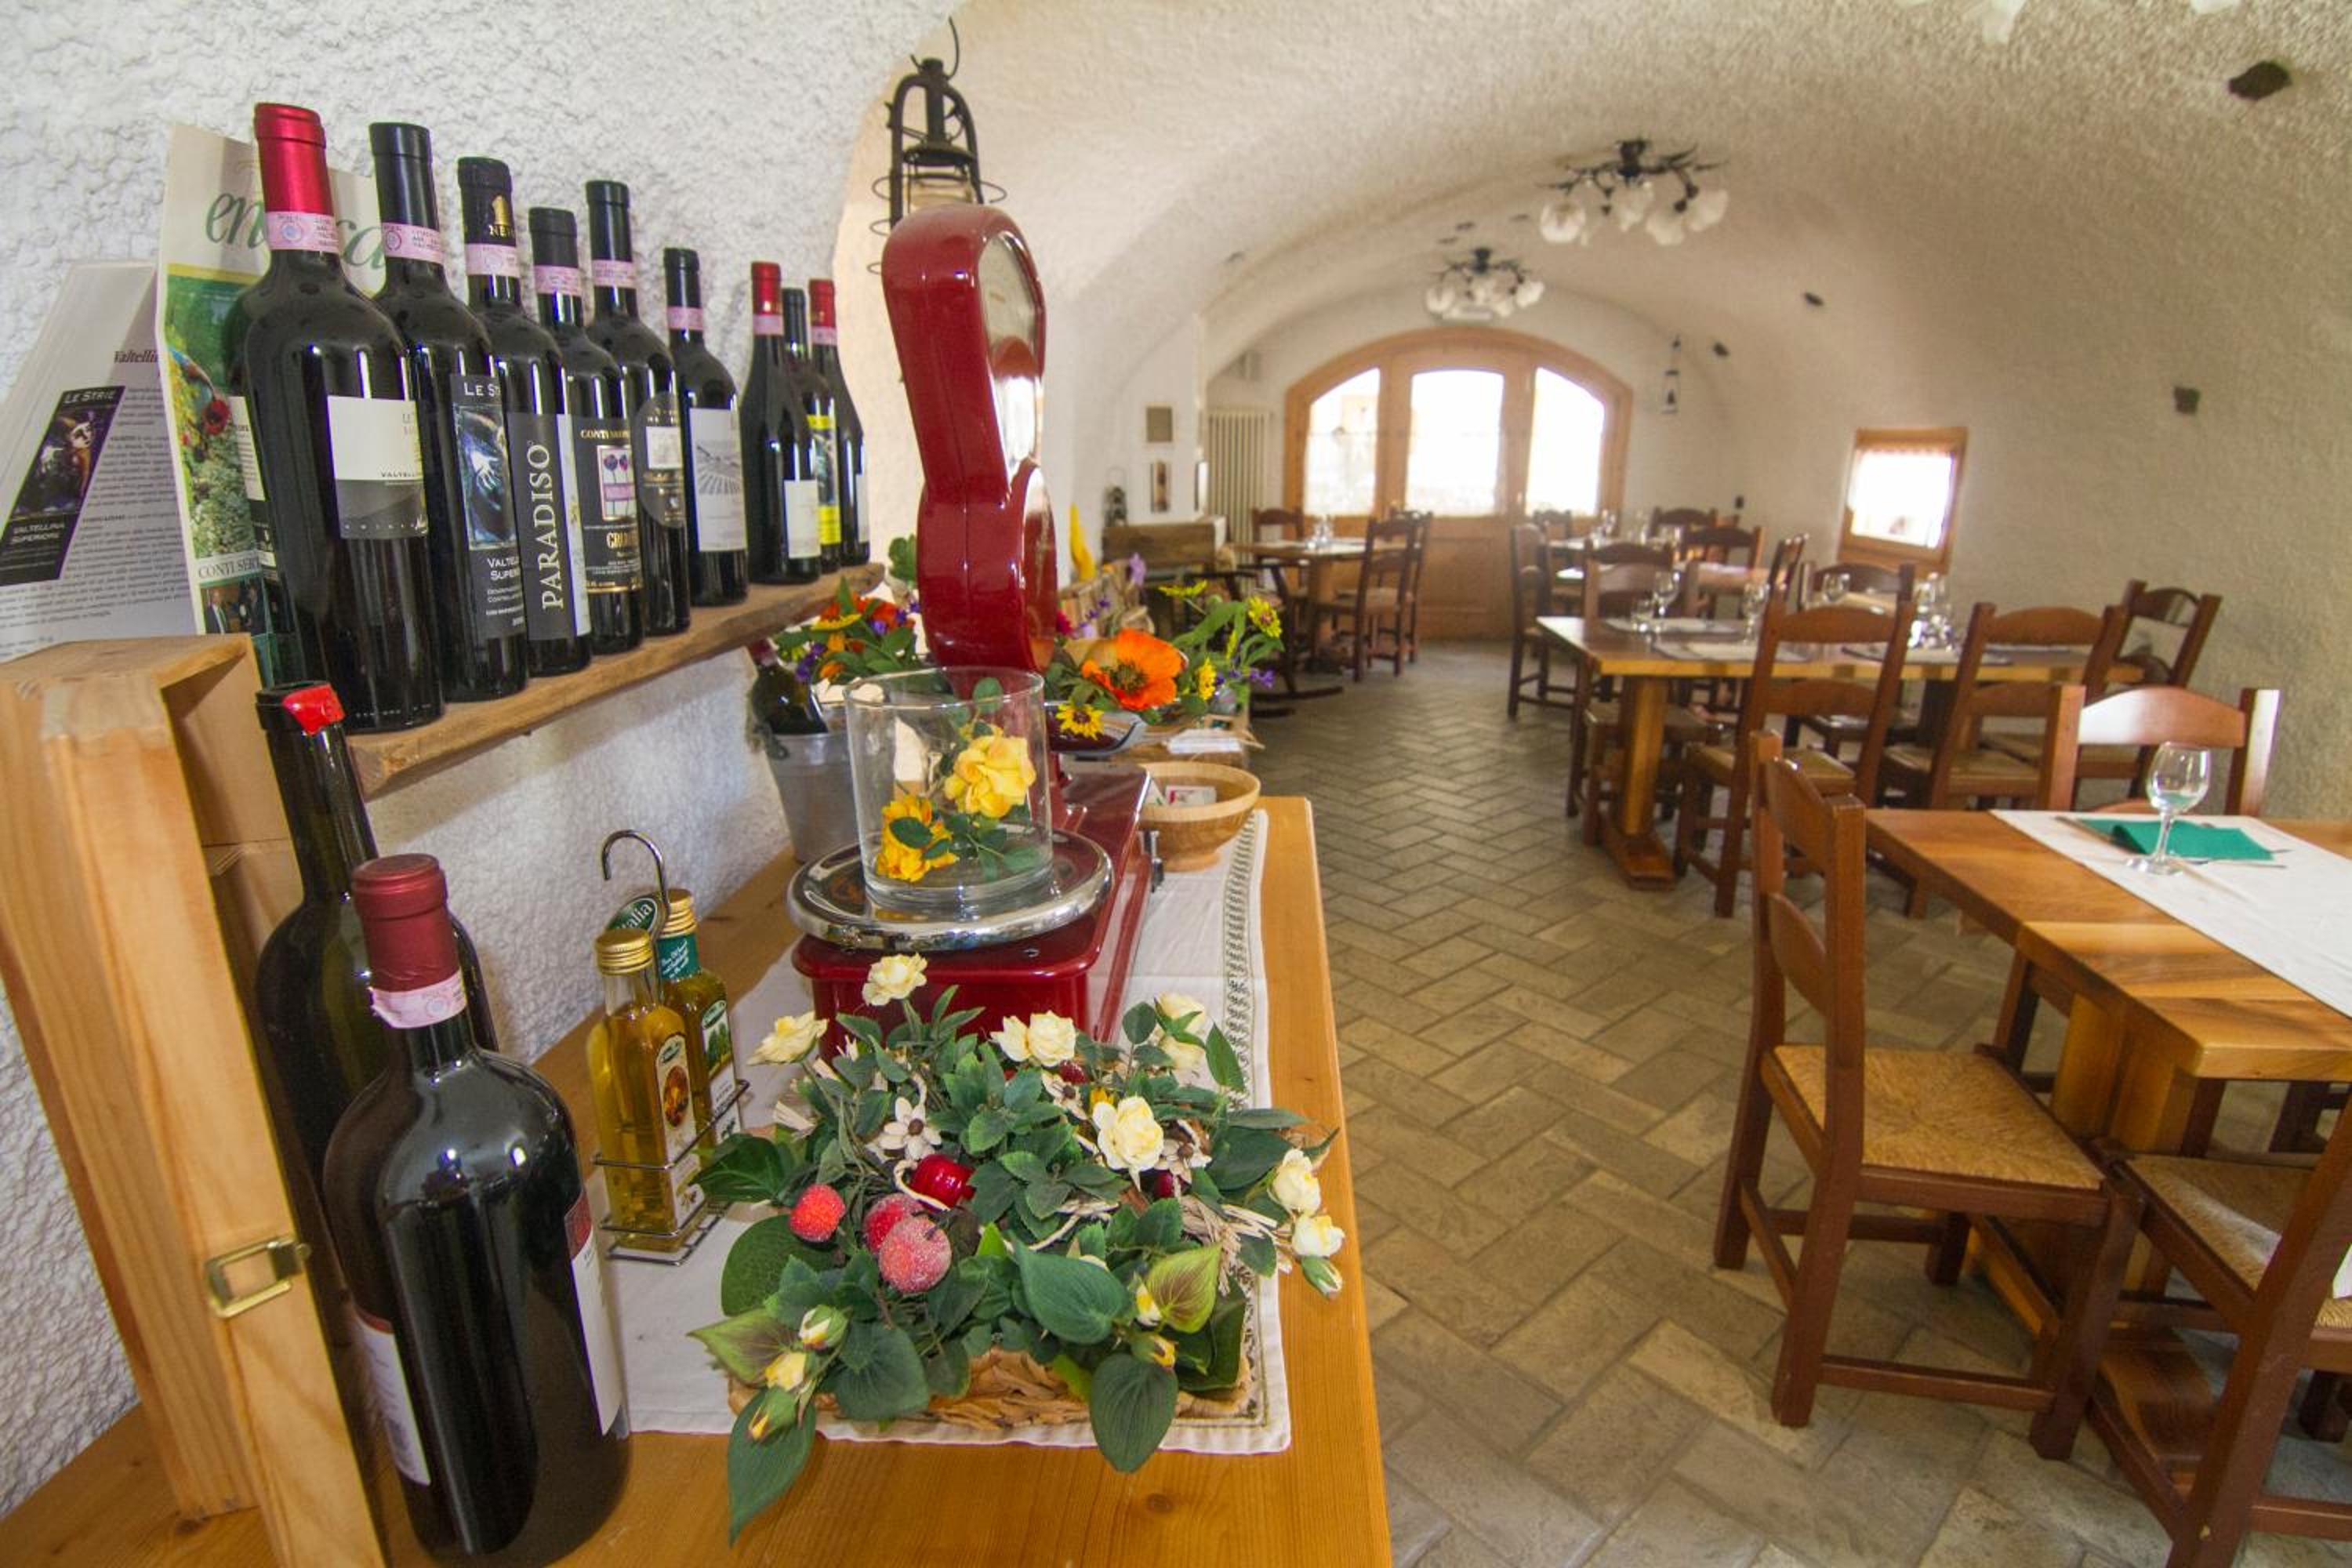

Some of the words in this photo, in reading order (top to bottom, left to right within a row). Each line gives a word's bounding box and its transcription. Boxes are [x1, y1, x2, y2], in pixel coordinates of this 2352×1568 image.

[463, 382, 485, 397] LE
[527, 443, 564, 610] PARADISO
[198, 561, 235, 578] CONTI
